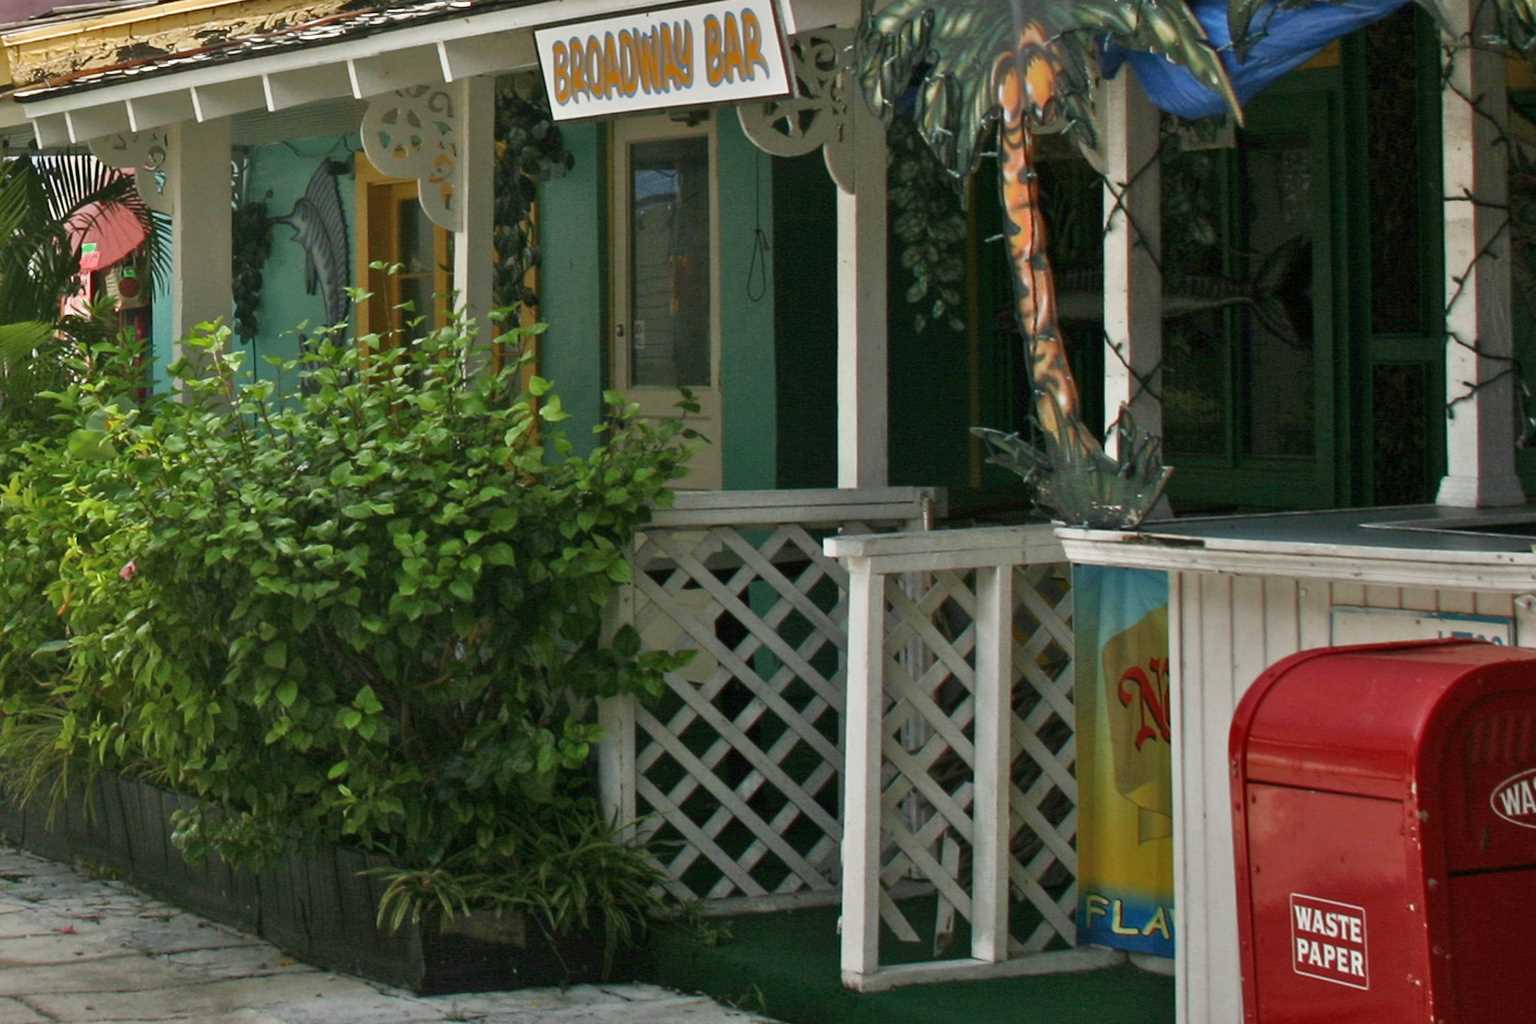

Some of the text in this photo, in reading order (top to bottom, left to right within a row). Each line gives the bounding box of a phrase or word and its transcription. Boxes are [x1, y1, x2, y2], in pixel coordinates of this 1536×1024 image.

[553, 8, 770, 106] BROADWAY BAR
[1500, 776, 1536, 816] WA
[1086, 893, 1175, 940] FLA
[1294, 905, 1363, 944] WASTE
[1296, 937, 1365, 977] PAPER
